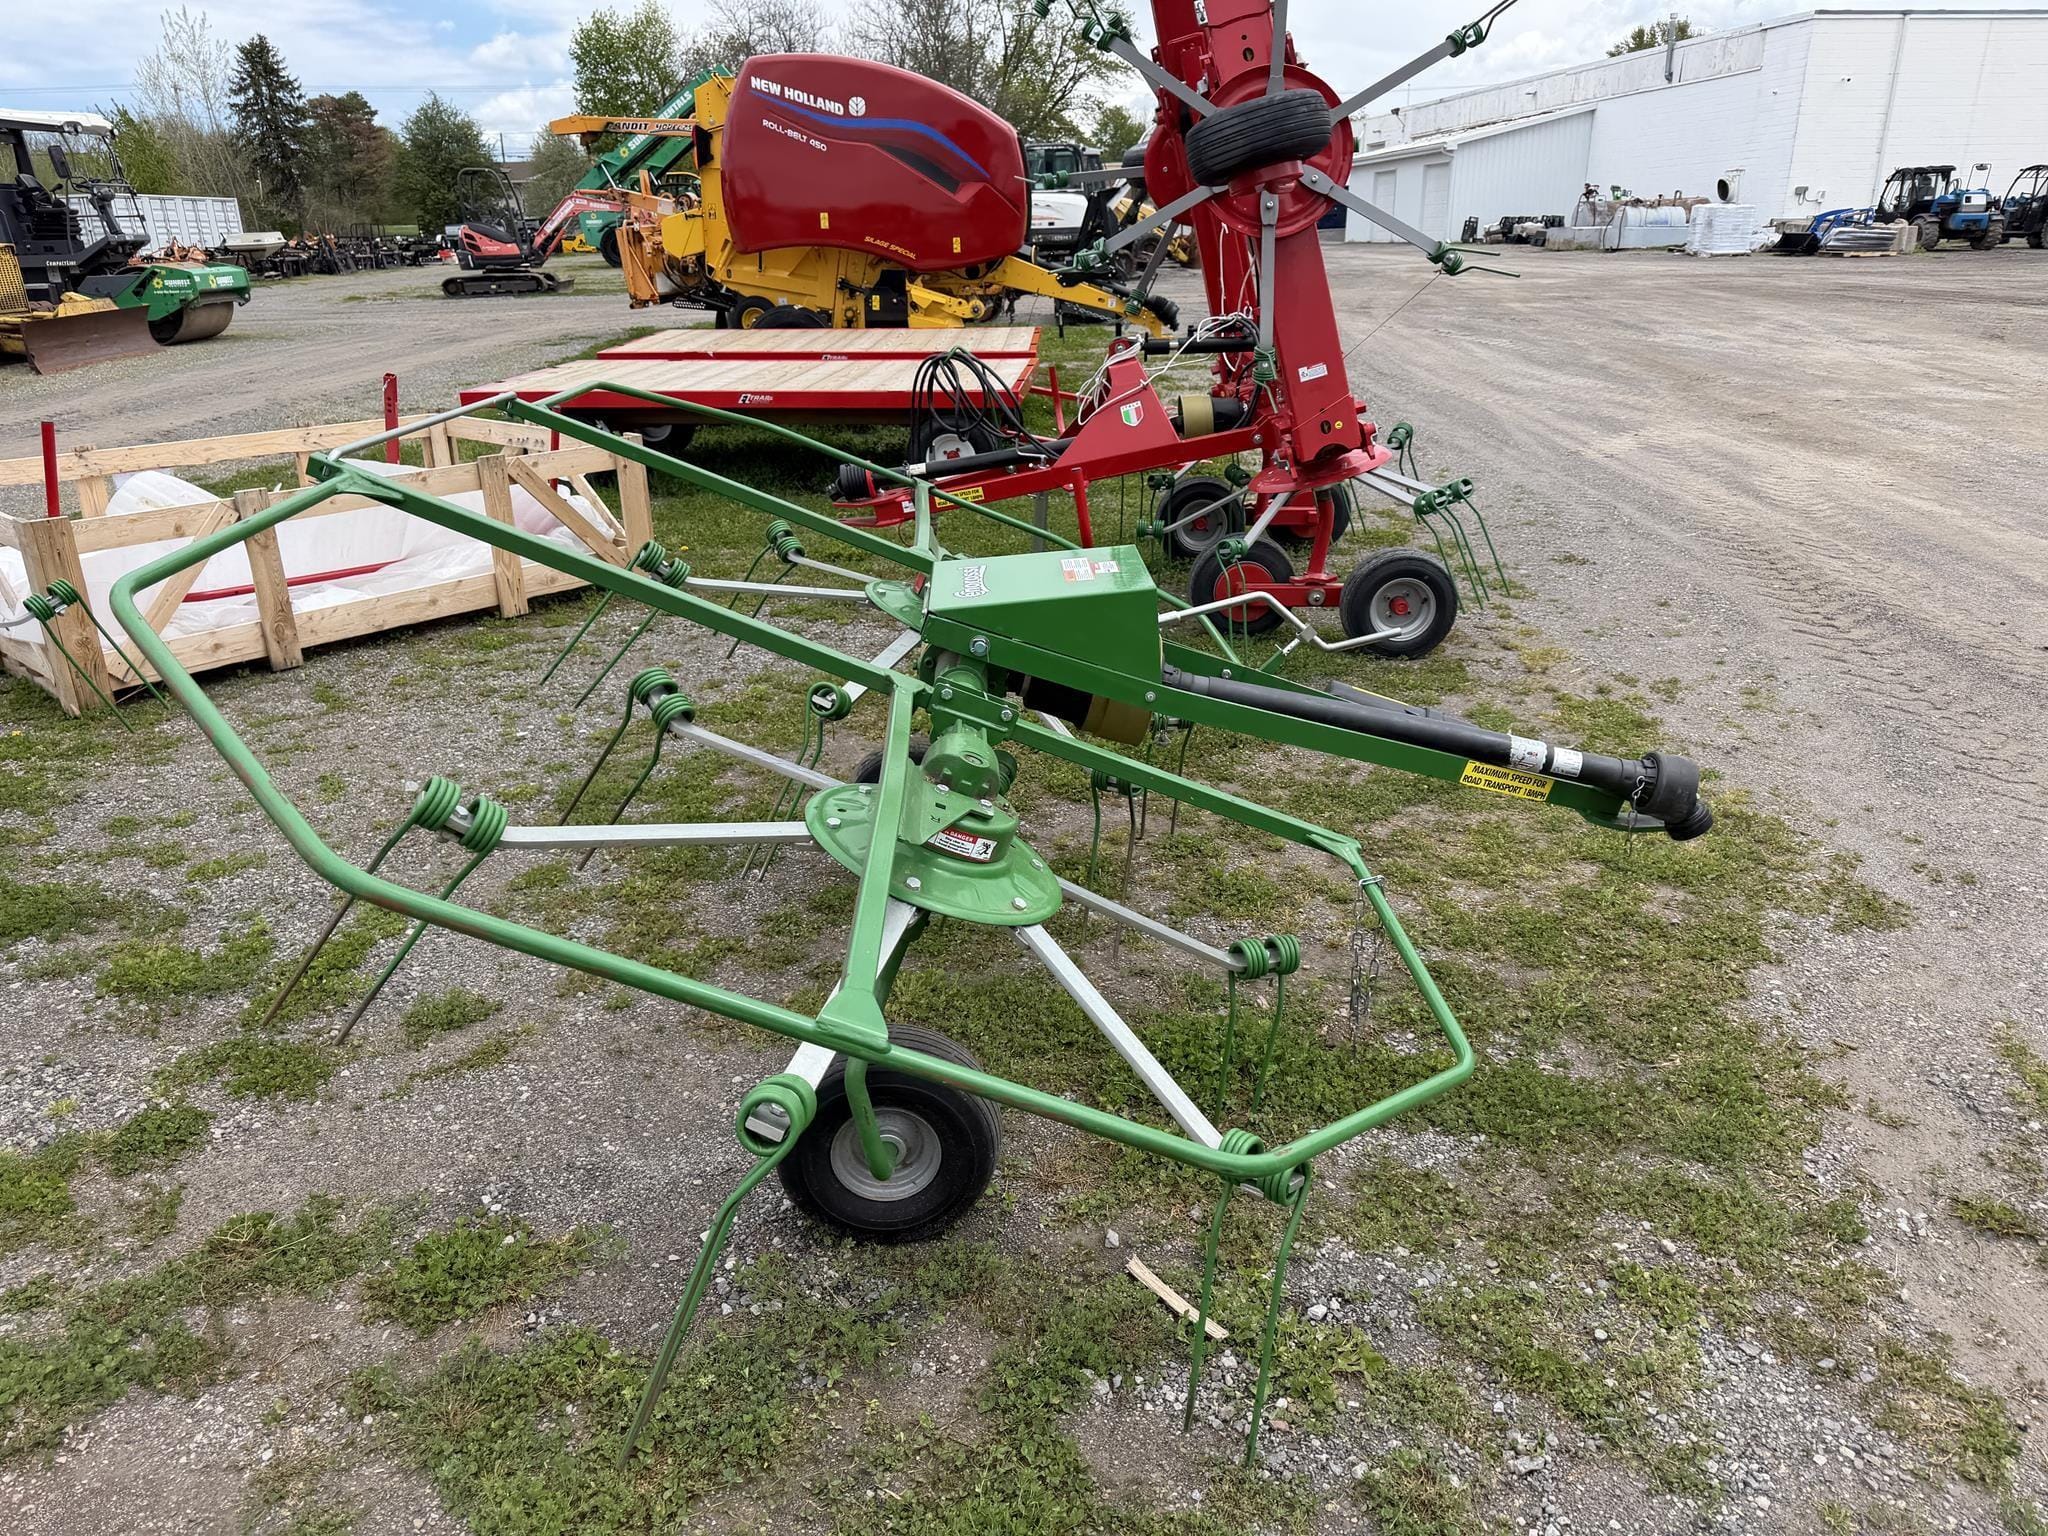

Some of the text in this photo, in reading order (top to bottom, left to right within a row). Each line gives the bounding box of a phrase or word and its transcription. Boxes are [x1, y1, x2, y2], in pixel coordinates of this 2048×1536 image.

[750, 76, 844, 115] NEW HOLLAND
[762, 119, 827, 151] ROLL-BELT 450
[864, 236, 916, 259] SILAGE SPECIAL
[1462, 774, 1546, 800] ROAD TRANSPORT 18MPH
[1472, 765, 1548, 788] MAXIMUM SPEED FOR
[950, 831, 973, 842] DANGER
